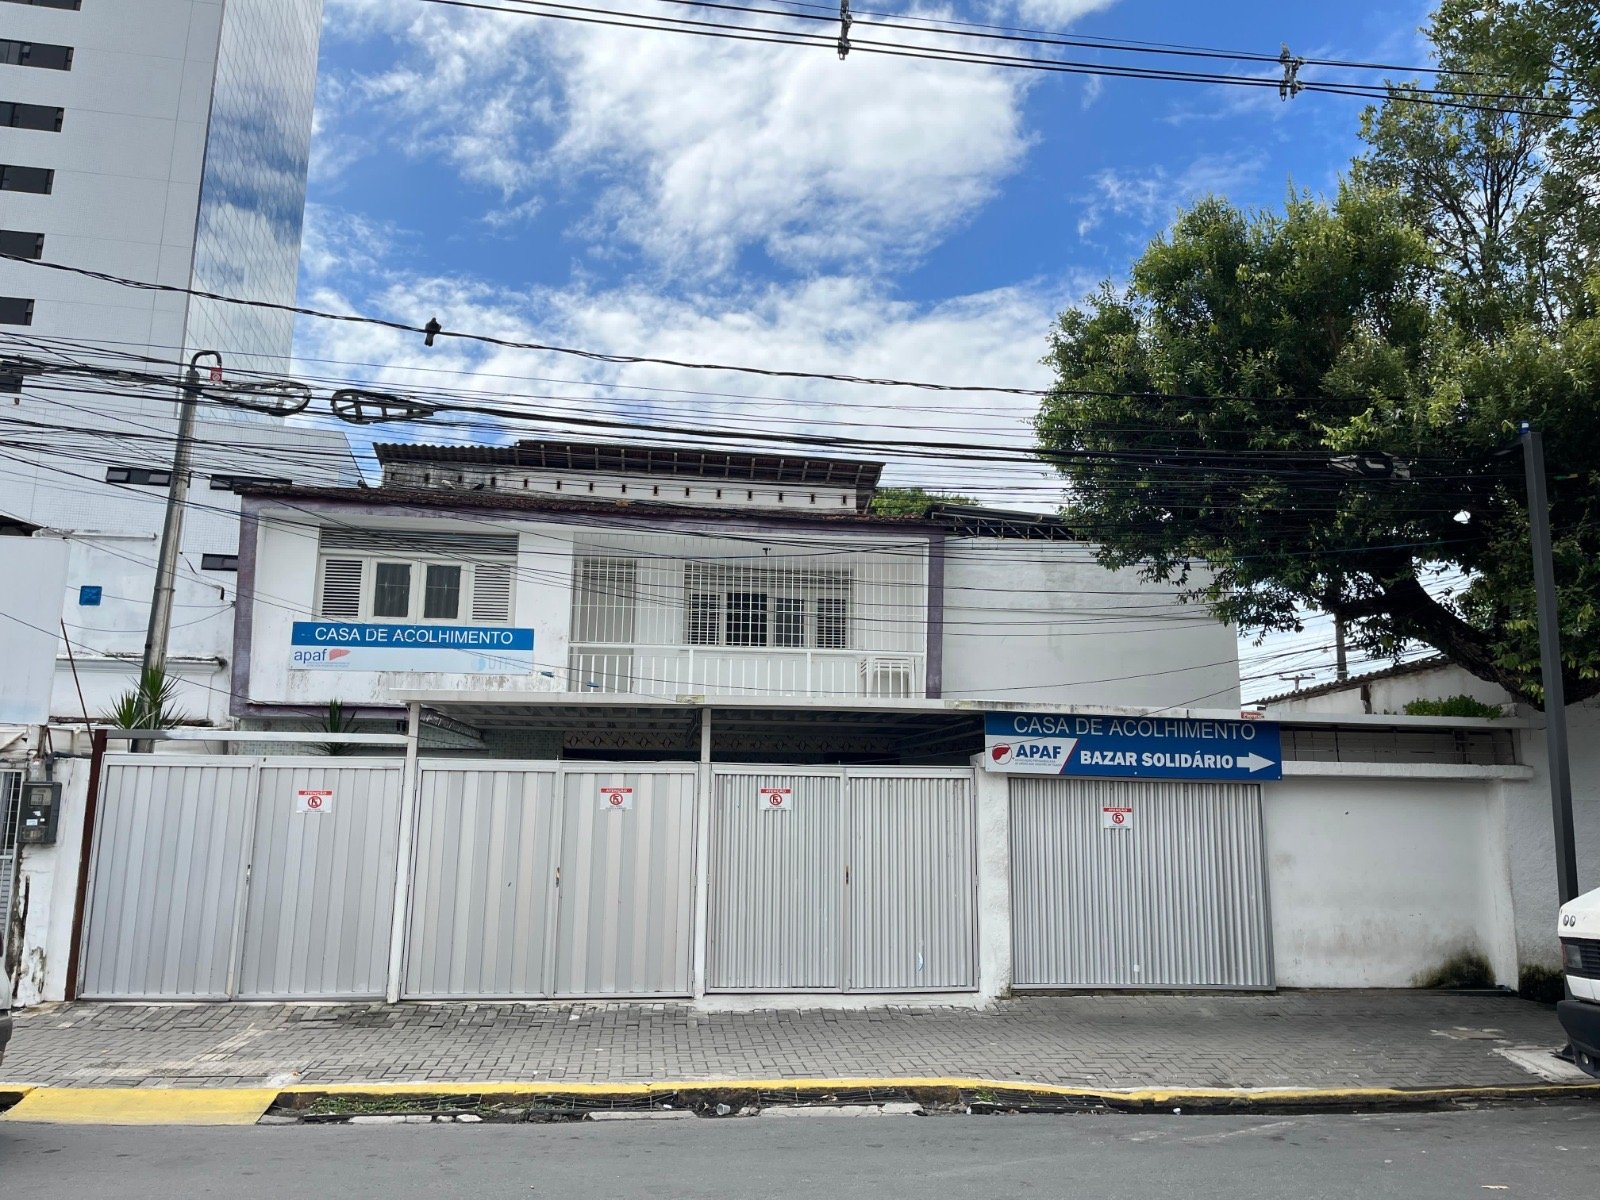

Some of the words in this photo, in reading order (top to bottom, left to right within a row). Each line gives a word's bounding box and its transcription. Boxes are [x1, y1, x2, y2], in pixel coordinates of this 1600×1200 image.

[315, 627, 360, 642] CASA
[365, 628, 388, 642] DE
[392, 628, 513, 645] ACOLHIMENTO
[294, 648, 328, 664] apaf
[1013, 716, 1070, 735] CASA
[1075, 718, 1104, 736] DE
[1108, 719, 1256, 740] ACOLHIMENTO
[1015, 744, 1062, 759] APAF
[1080, 751, 1137, 767] BAZAR
[1141, 751, 1234, 769] SOLIDÁRIO
